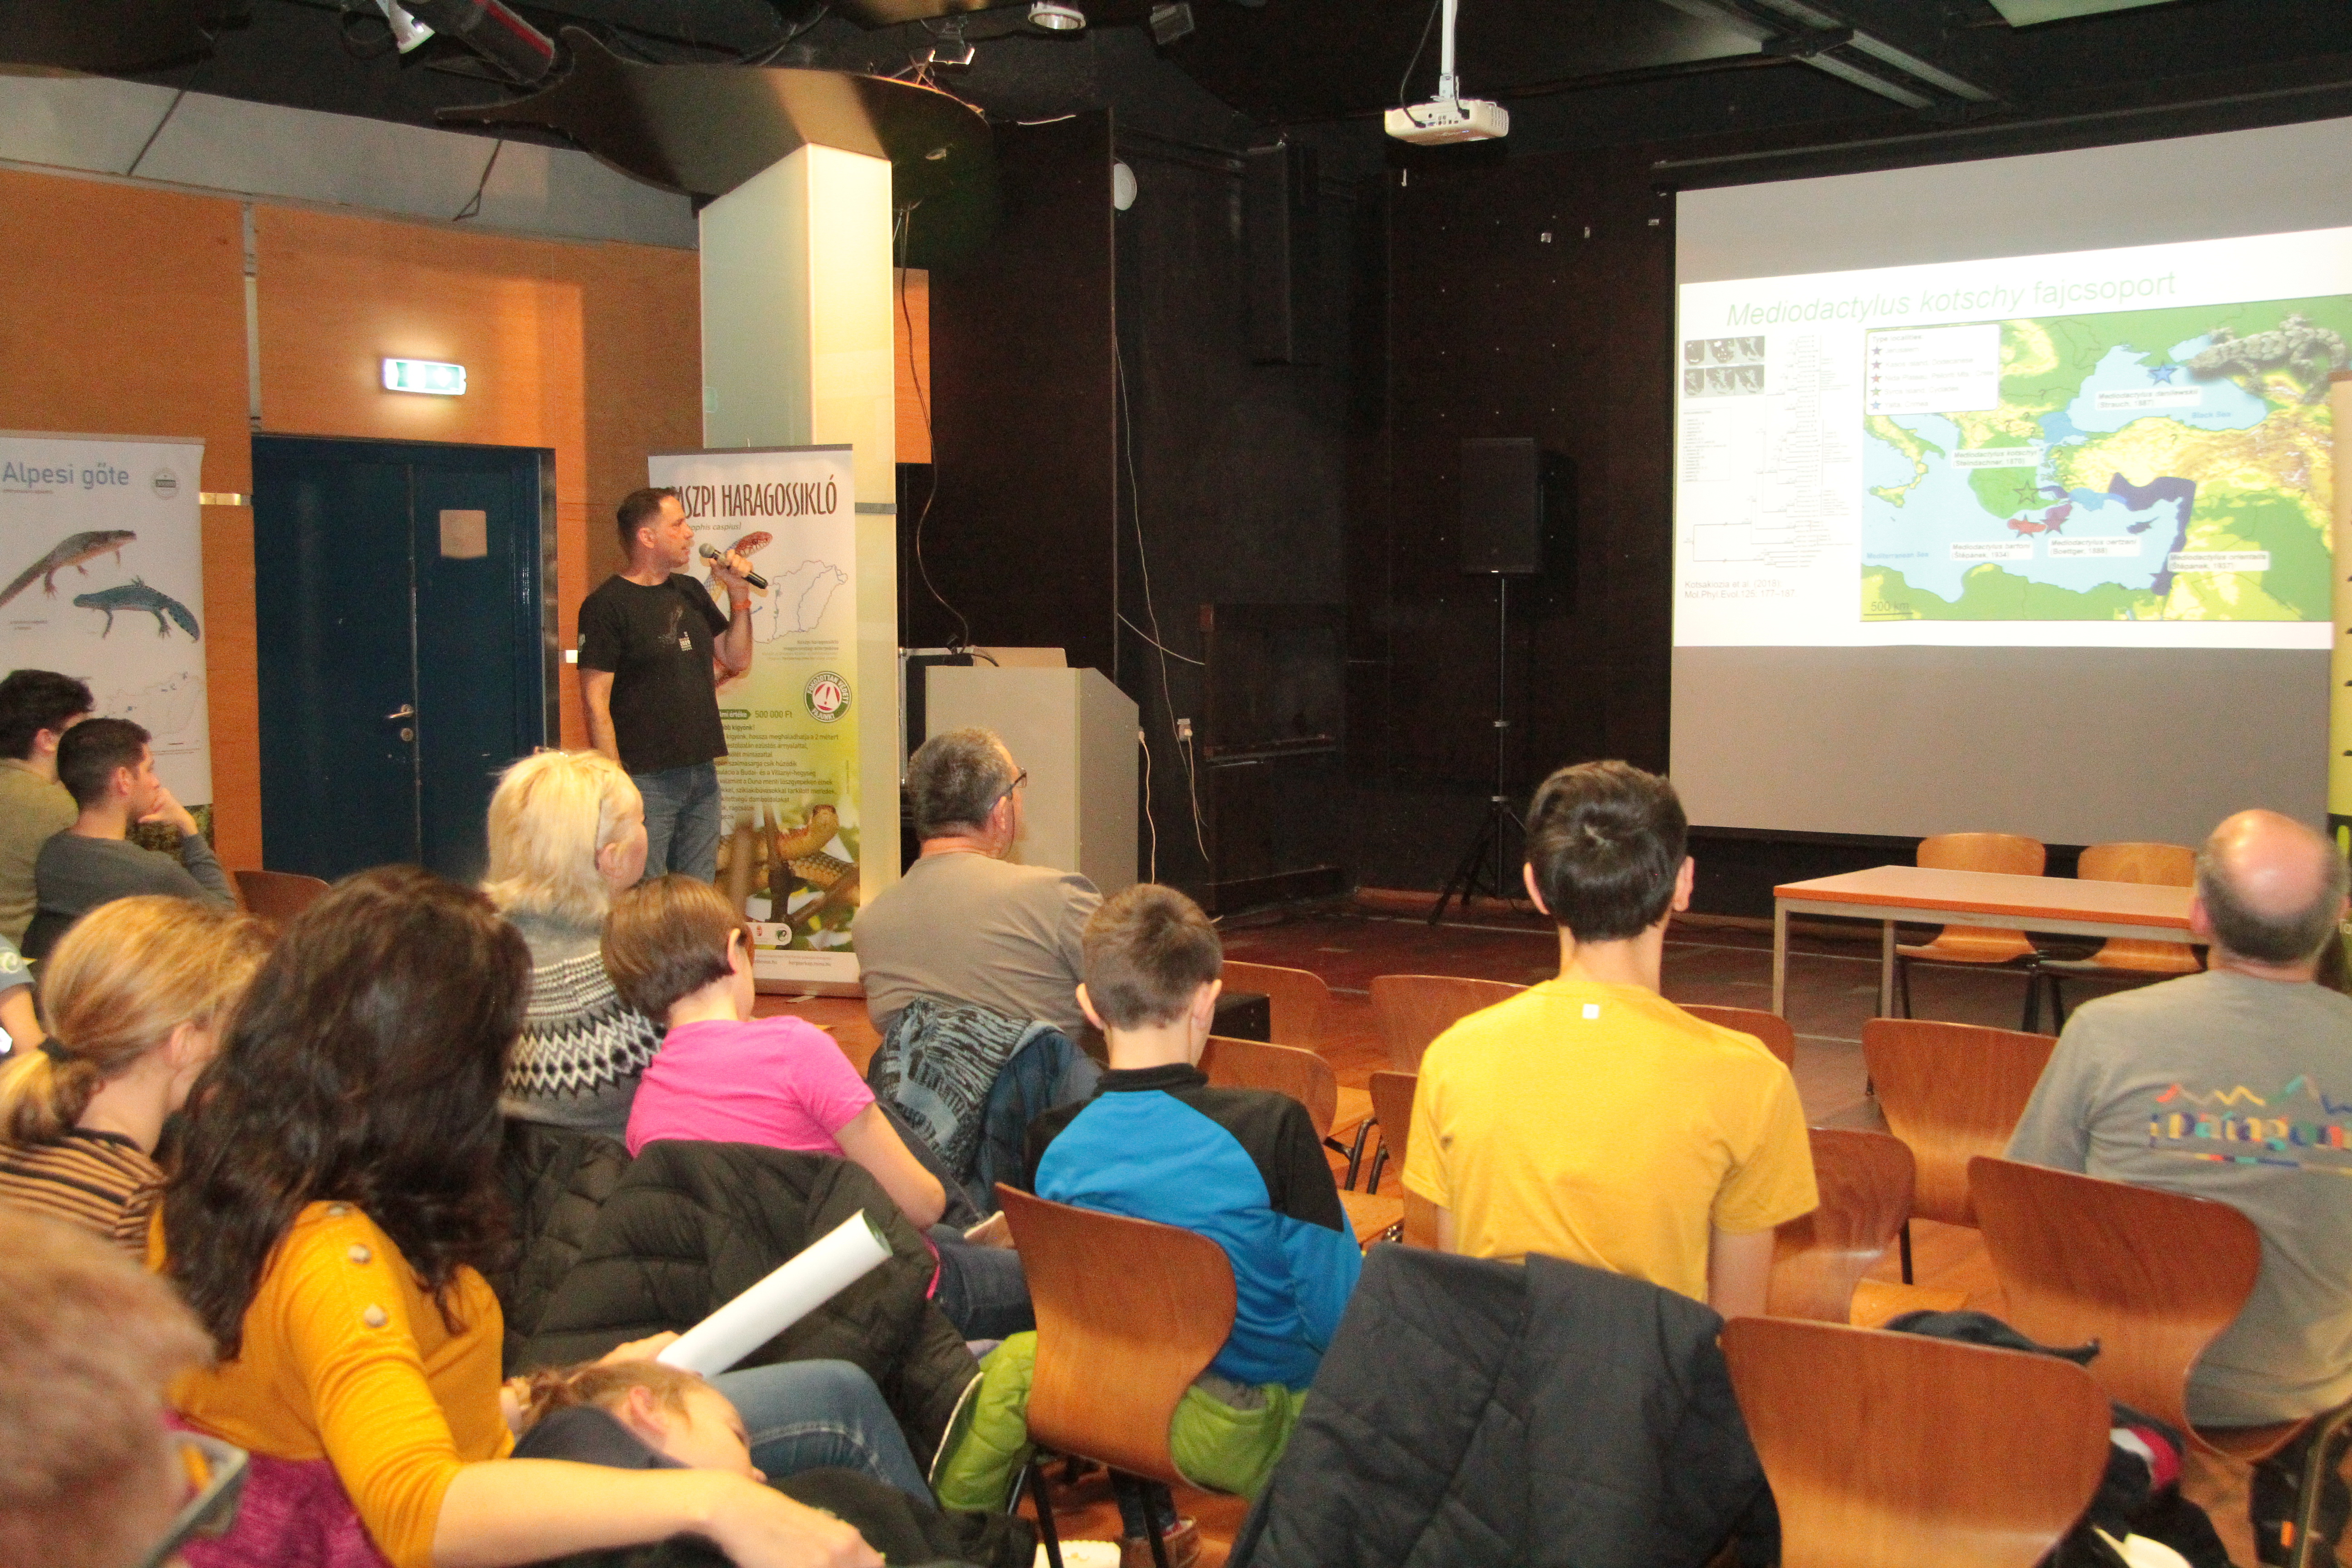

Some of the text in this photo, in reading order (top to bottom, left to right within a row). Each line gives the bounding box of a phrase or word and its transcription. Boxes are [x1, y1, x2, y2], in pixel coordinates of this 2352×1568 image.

[1727, 271, 2175, 326] Mediodactylus kotschy fajcsoport
[3, 462, 74, 488] Alpesi
[678, 474, 838, 519] ASZPI HARAGOSSIKLÓ
[689, 523, 710, 532] ophis
[1732, 580, 1740, 588] et
[1871, 600, 1910, 612] 500 km
[807, 674, 839, 695] FOKOZOTTAN
[755, 710, 793, 718] 500 000 Ft
